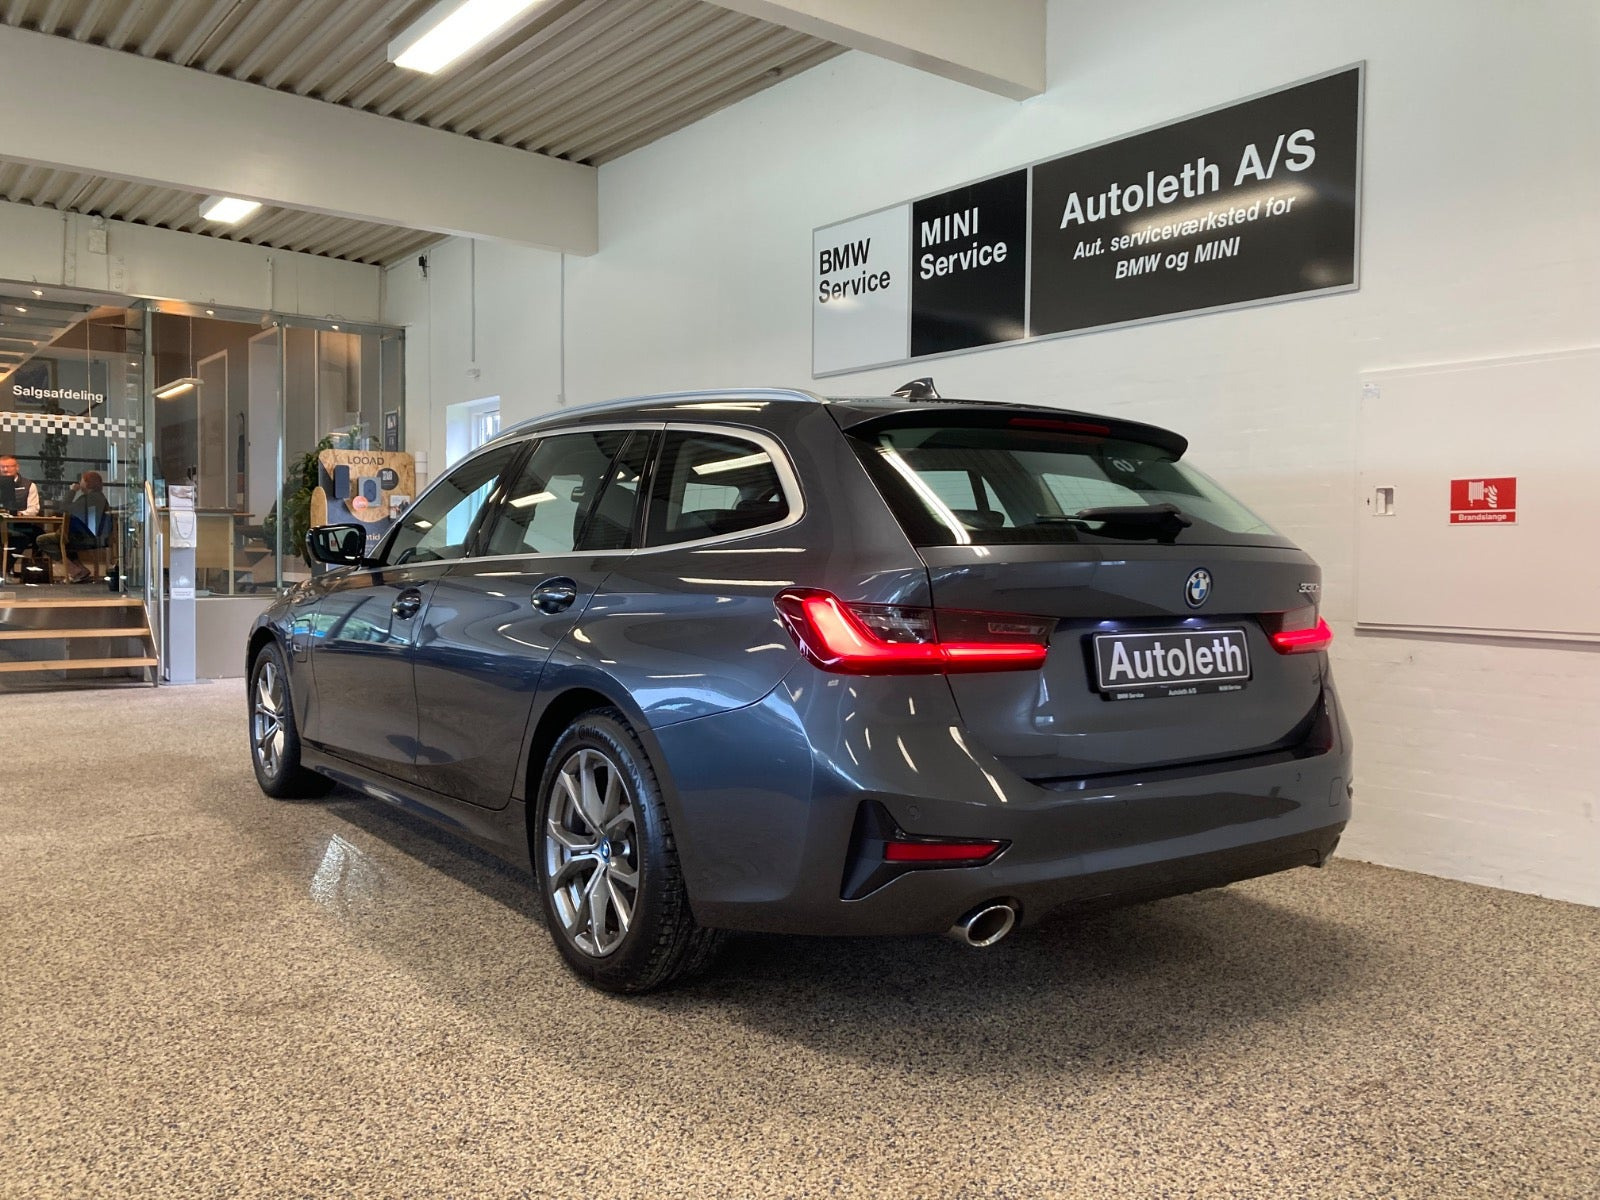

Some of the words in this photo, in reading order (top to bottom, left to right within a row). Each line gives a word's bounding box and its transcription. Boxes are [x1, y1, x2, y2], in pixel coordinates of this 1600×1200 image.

[1060, 157, 1220, 229] Autoleth
[1233, 128, 1316, 186] A/S
[921, 207, 979, 248] MINI
[1073, 241, 1105, 260] Aut.
[1110, 200, 1260, 252] serviceværksted
[1265, 196, 1297, 218] for
[819, 238, 871, 275] BMW
[919, 242, 1008, 280] Service
[1115, 253, 1161, 279] BMW
[1165, 250, 1189, 272] og
[1194, 236, 1241, 264] MINI
[818, 270, 891, 304] Service
[12, 384, 104, 403] Salgsafdeling
[1458, 513, 1507, 522] Brandslange
[1109, 637, 1243, 680] Autoleth
